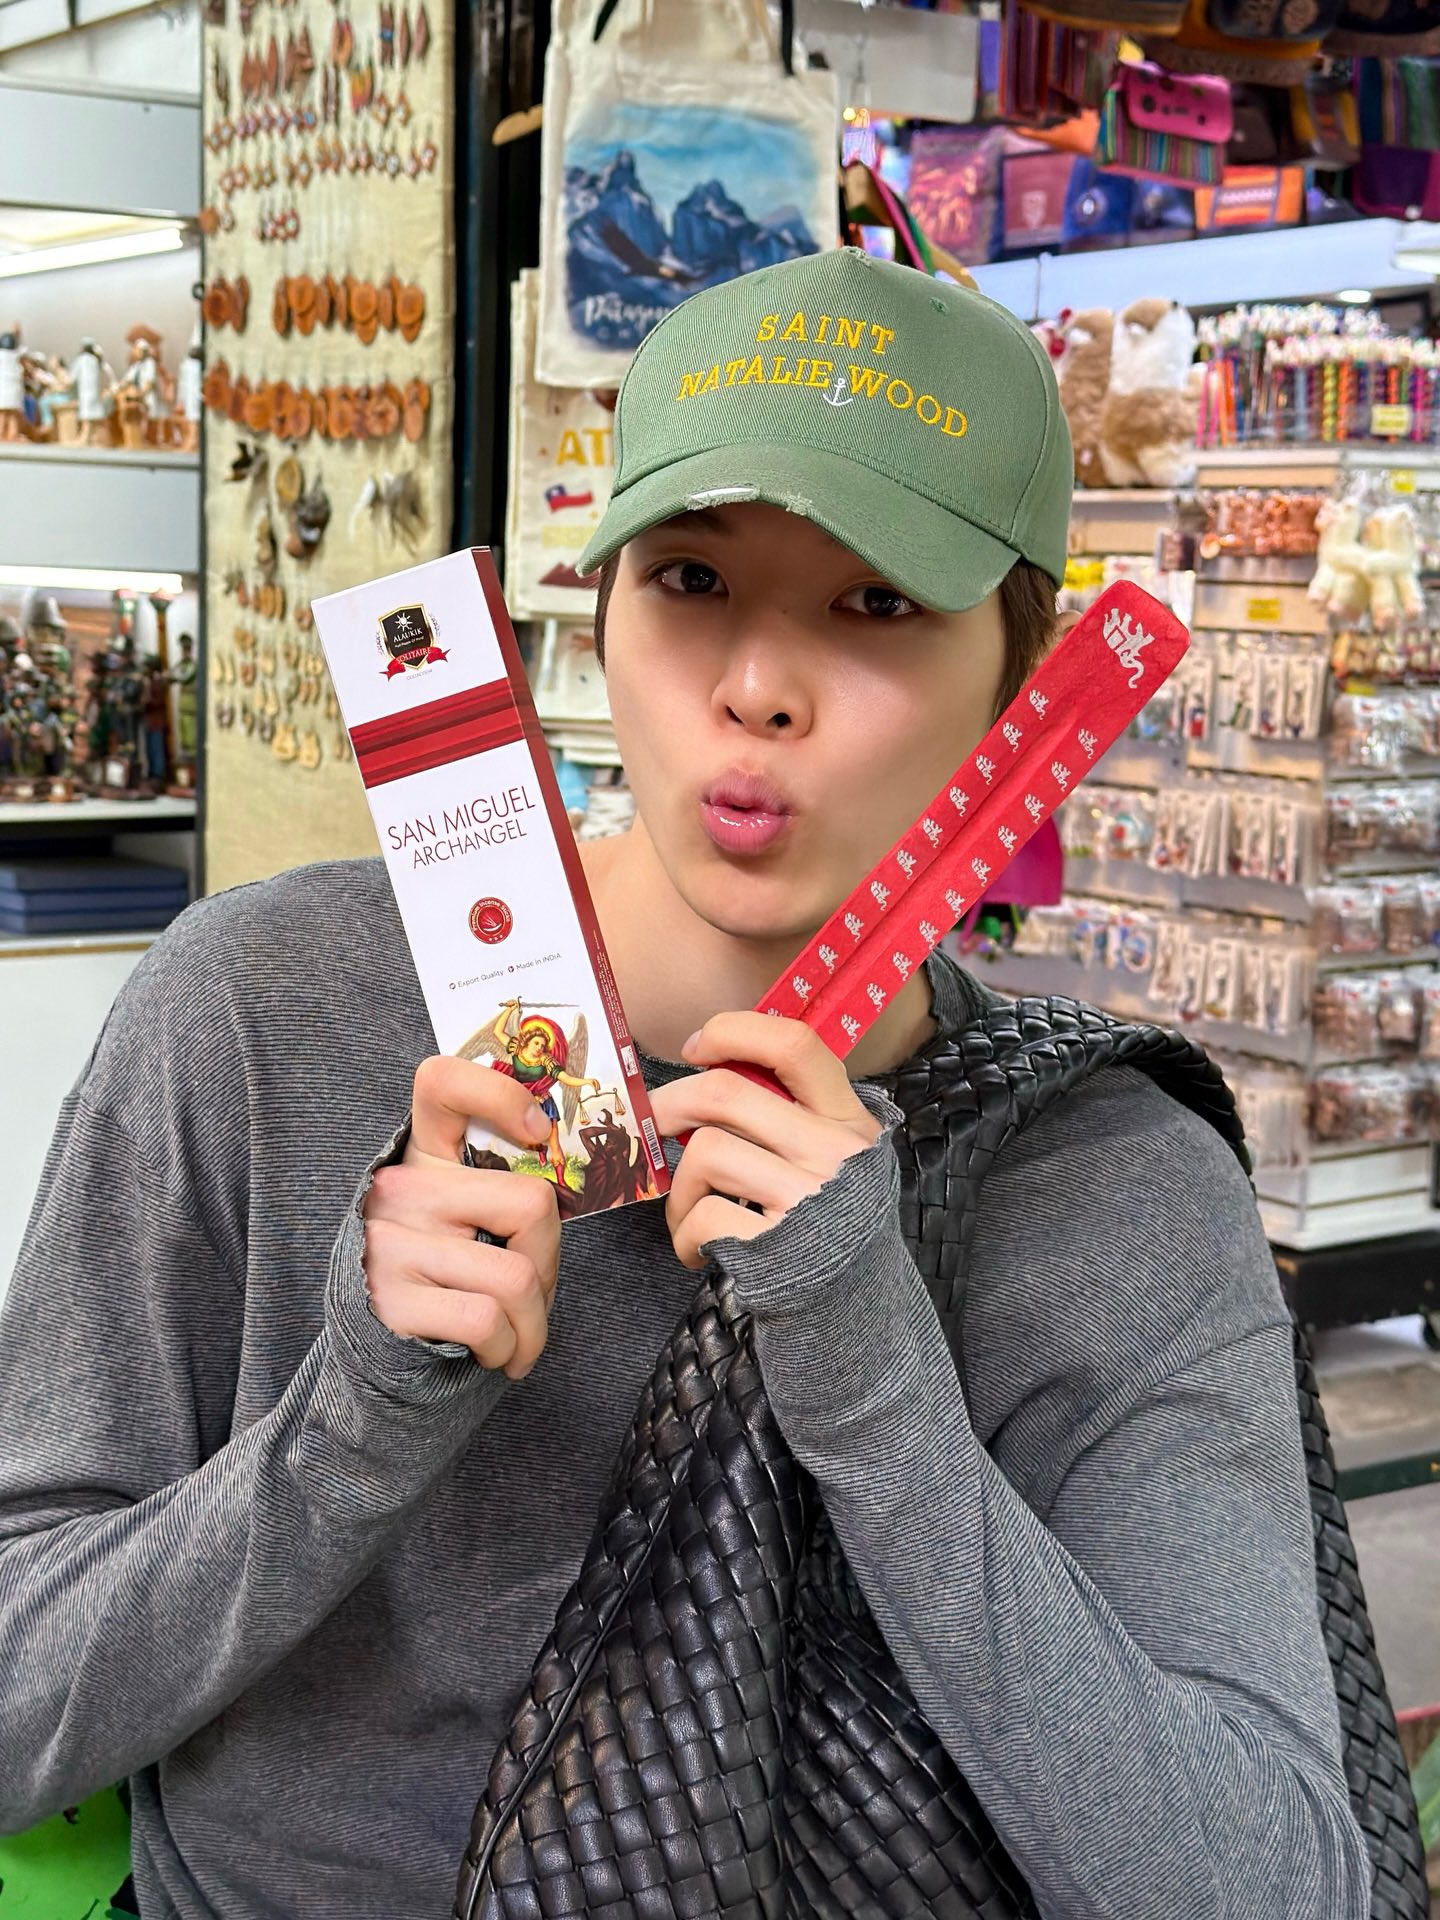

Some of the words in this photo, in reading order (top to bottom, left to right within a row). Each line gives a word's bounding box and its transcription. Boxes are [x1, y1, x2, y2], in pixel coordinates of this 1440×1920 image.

[755, 312, 895, 355] SAINT
[676, 355, 833, 401] NATALIE
[847, 365, 969, 438] WOOD
[393, 627, 423, 643] ALAUKIK
[396, 647, 431, 664] SOLITAIRE
[388, 814, 437, 850] SAN
[443, 785, 536, 834] MIGUEL
[413, 818, 527, 869] ARCHANGEL
[457, 976, 479, 987] Export
[481, 969, 504, 981] Quality
[516, 960, 534, 970] Made
[535, 957, 542, 965] in
